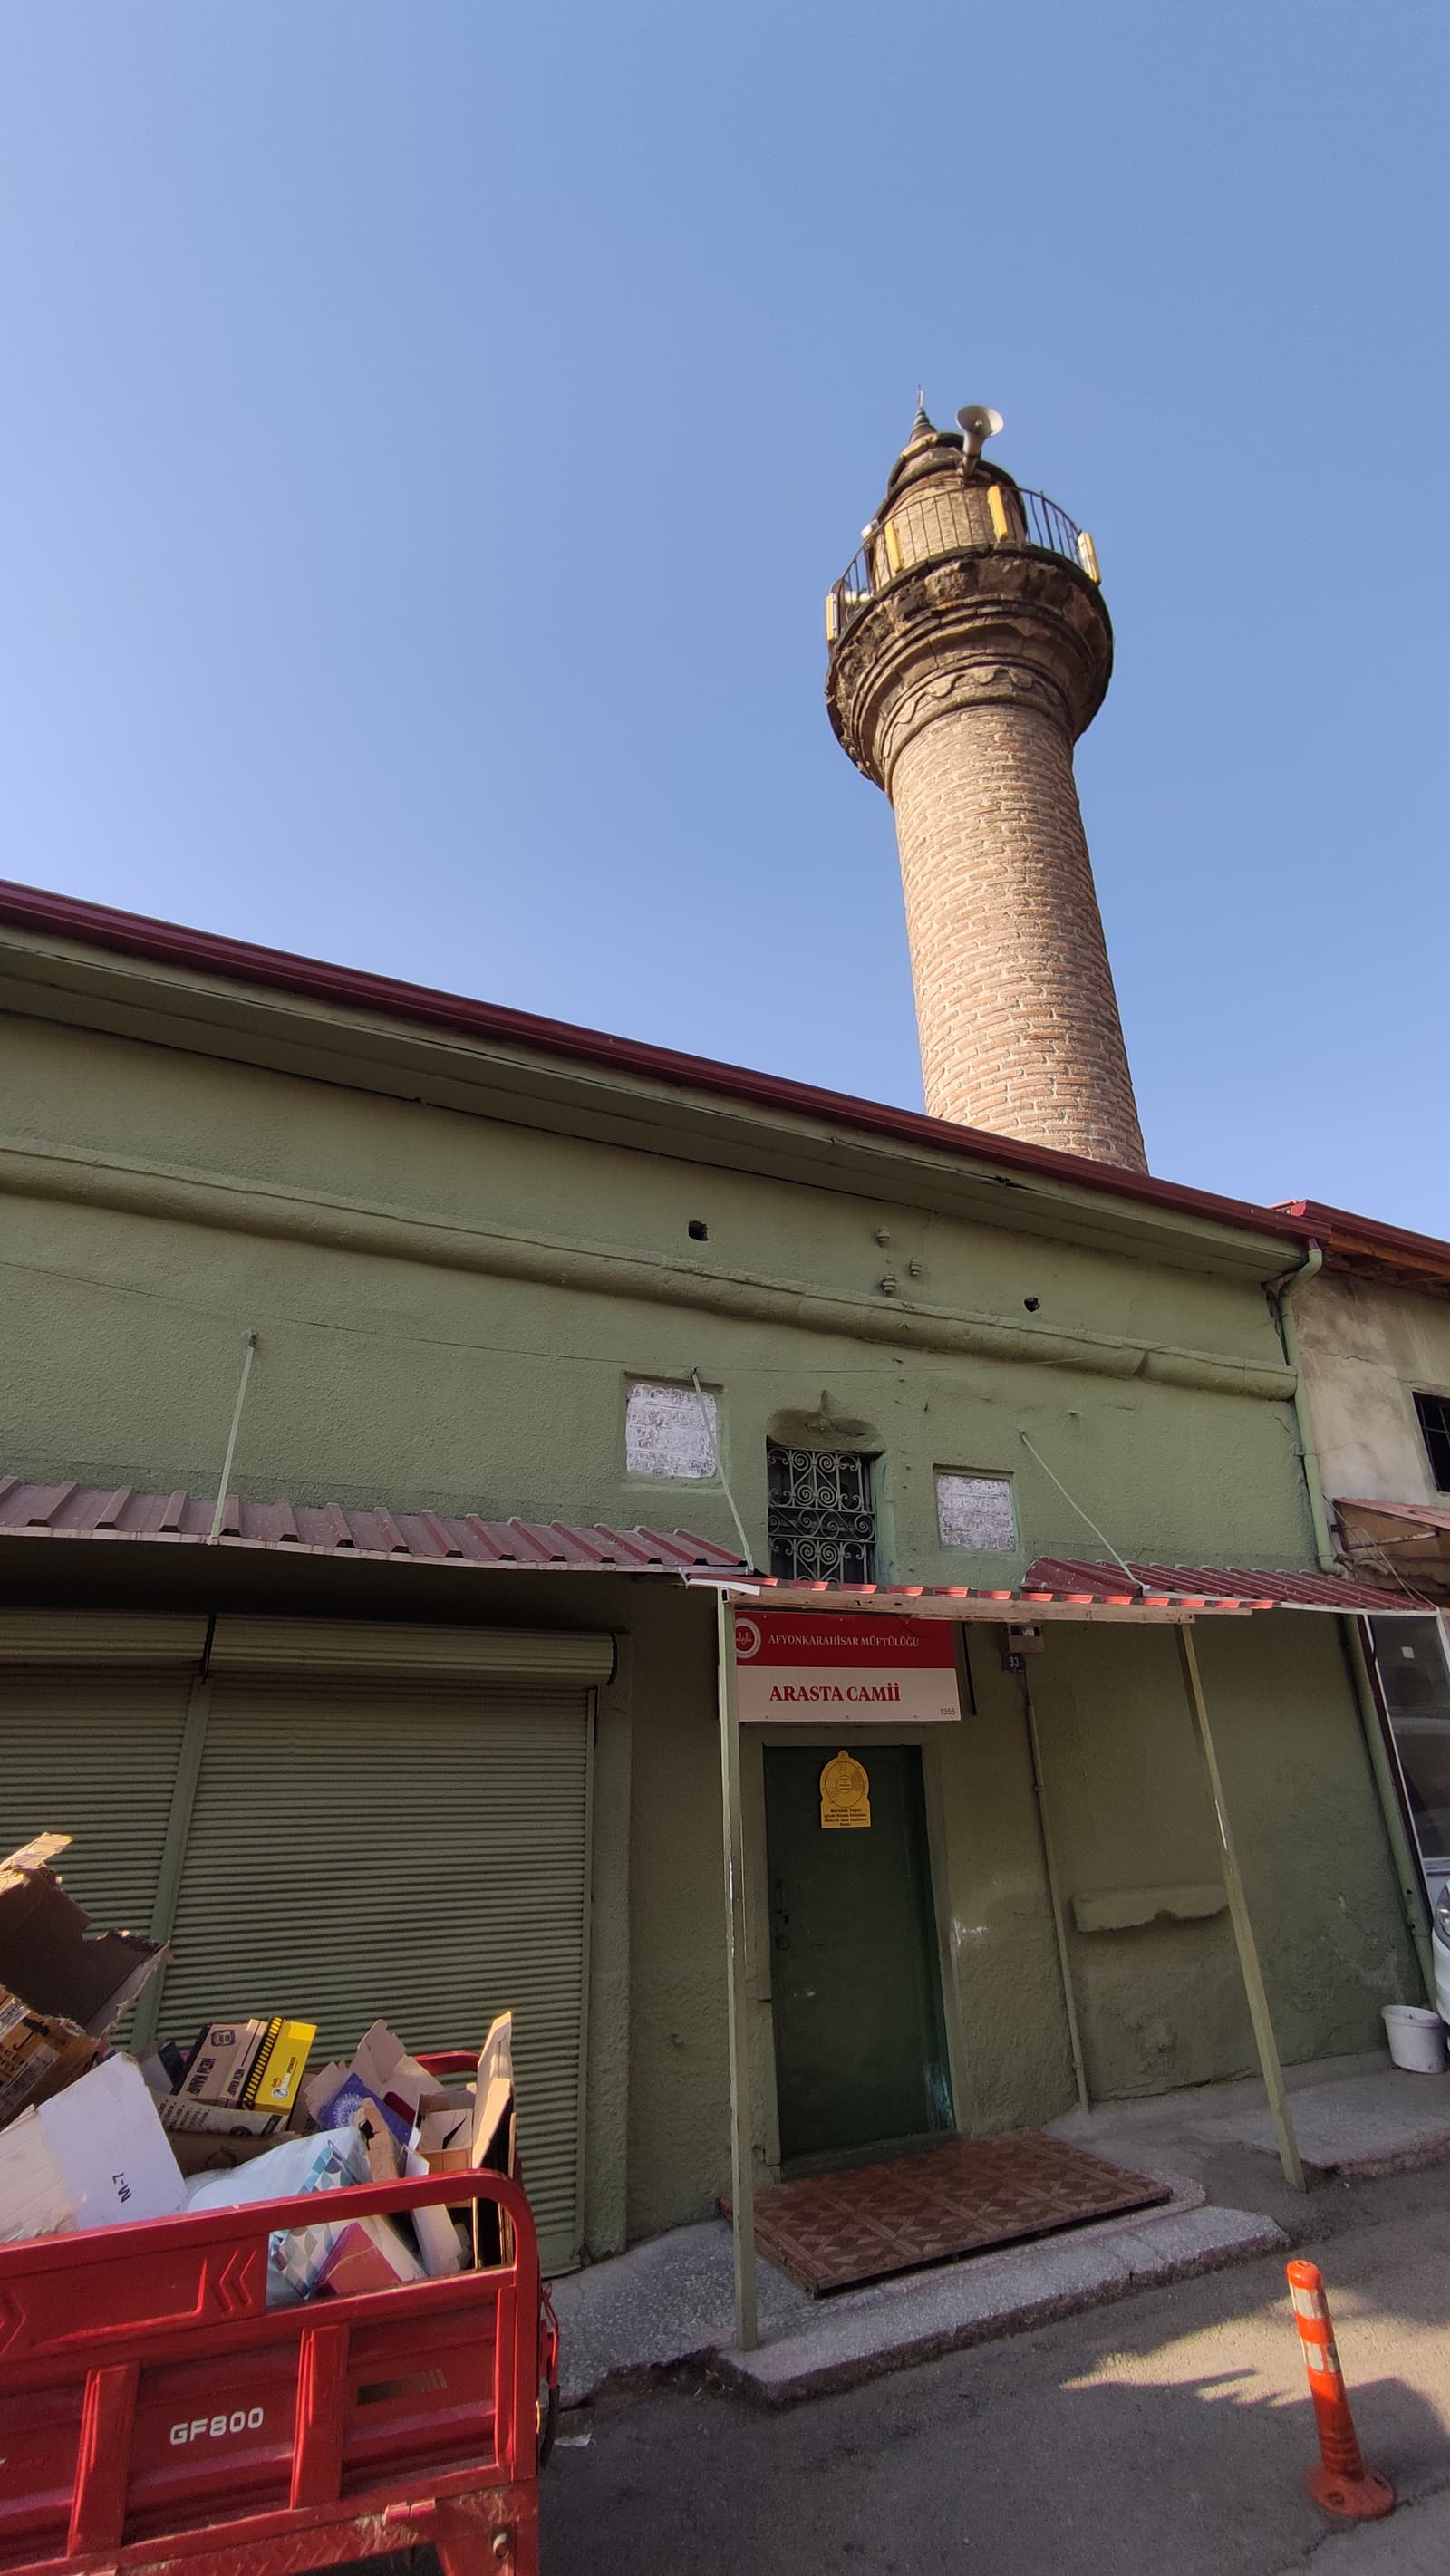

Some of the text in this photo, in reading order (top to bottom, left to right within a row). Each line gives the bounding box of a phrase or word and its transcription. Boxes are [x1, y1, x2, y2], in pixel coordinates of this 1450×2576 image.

[768, 1634, 859, 1646] AFYONKARAHİSAR
[1009, 1656, 1020, 1668] 33
[769, 1682, 901, 1702] ARASTA CAMİİ
[940, 1707, 956, 1716] 1355
[170, 2407, 264, 2445] GF800
